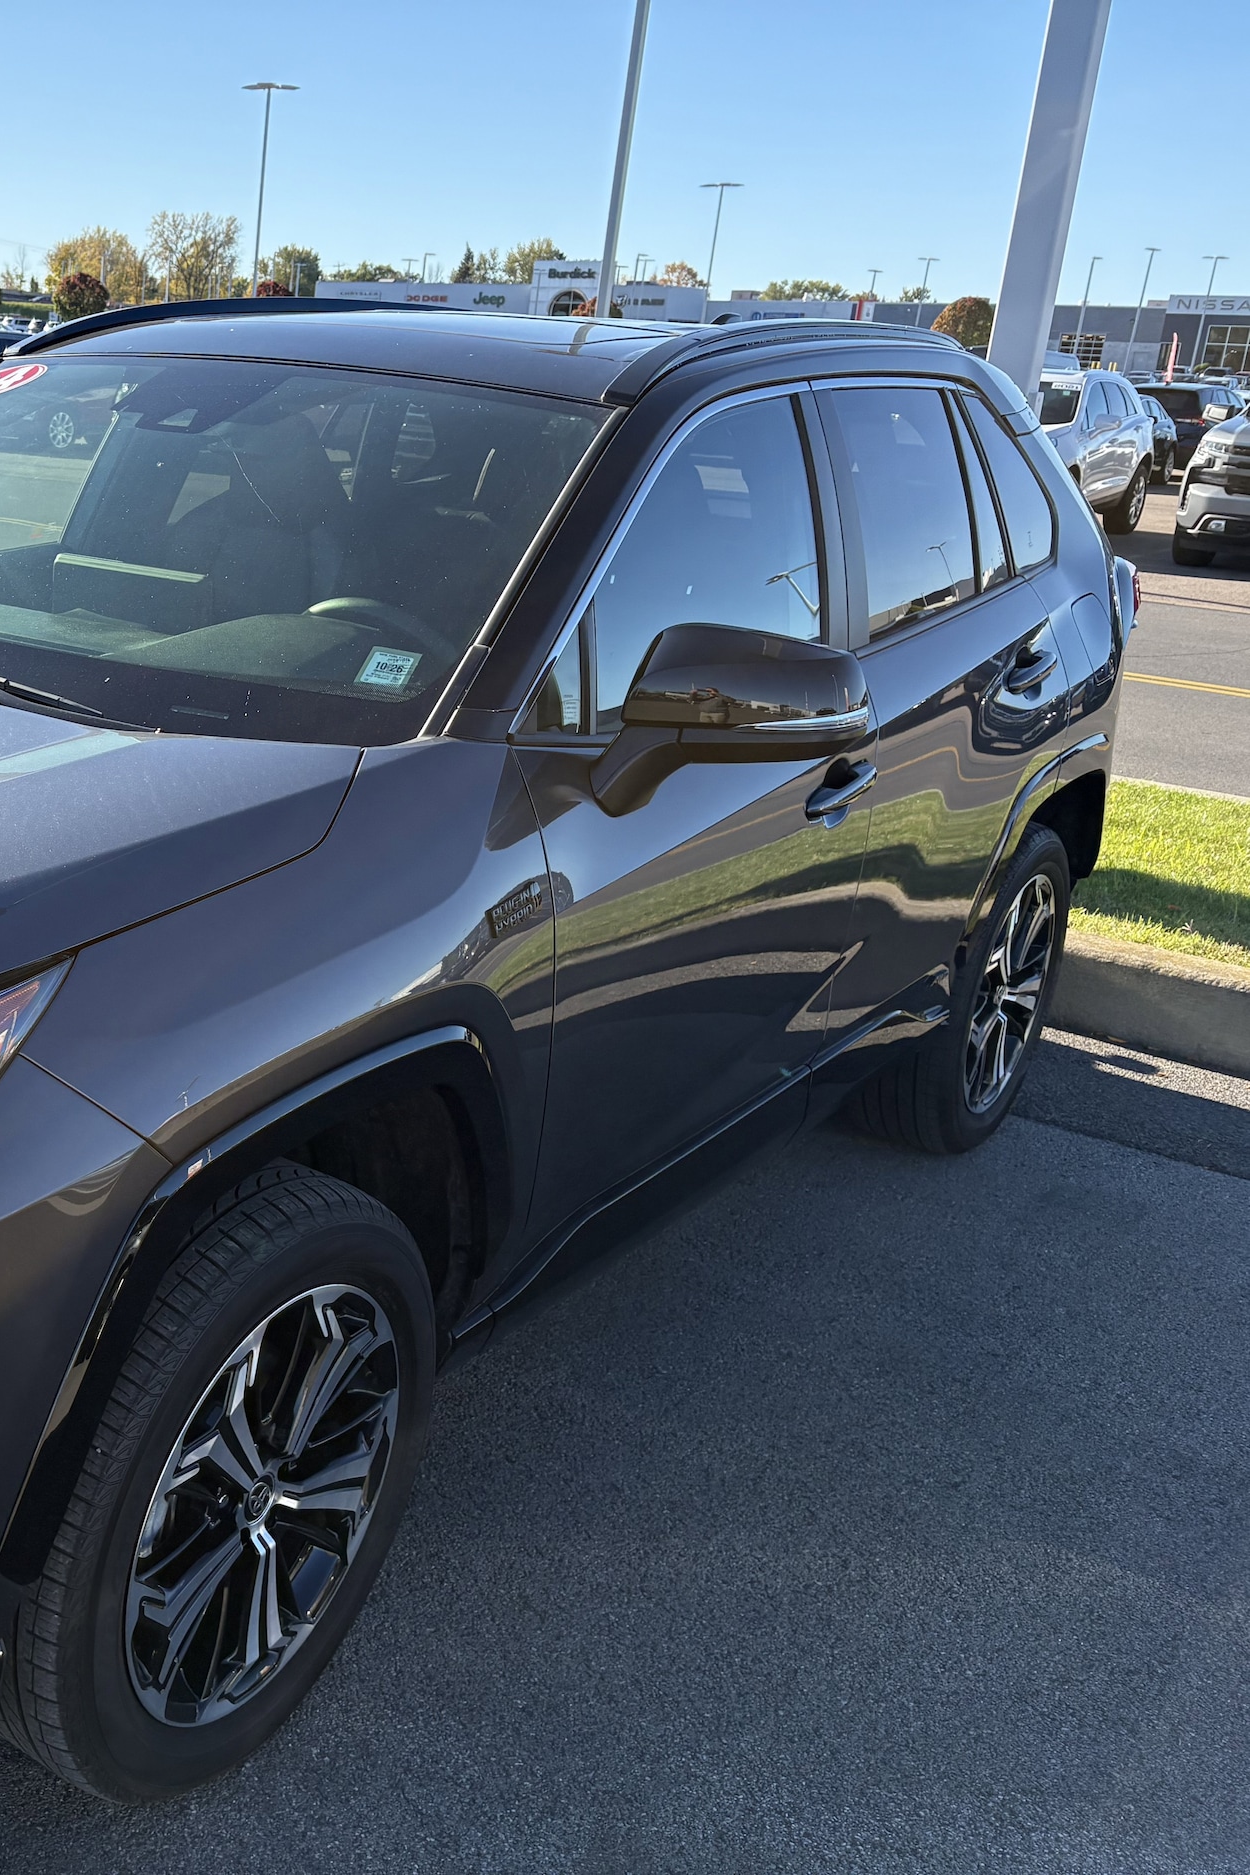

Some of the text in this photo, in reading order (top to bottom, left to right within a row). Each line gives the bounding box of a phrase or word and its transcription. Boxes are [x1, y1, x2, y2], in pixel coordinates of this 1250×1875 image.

[548, 266, 596, 279] Burdick
[406, 294, 448, 303] DODGE
[473, 291, 506, 308] Jeep
